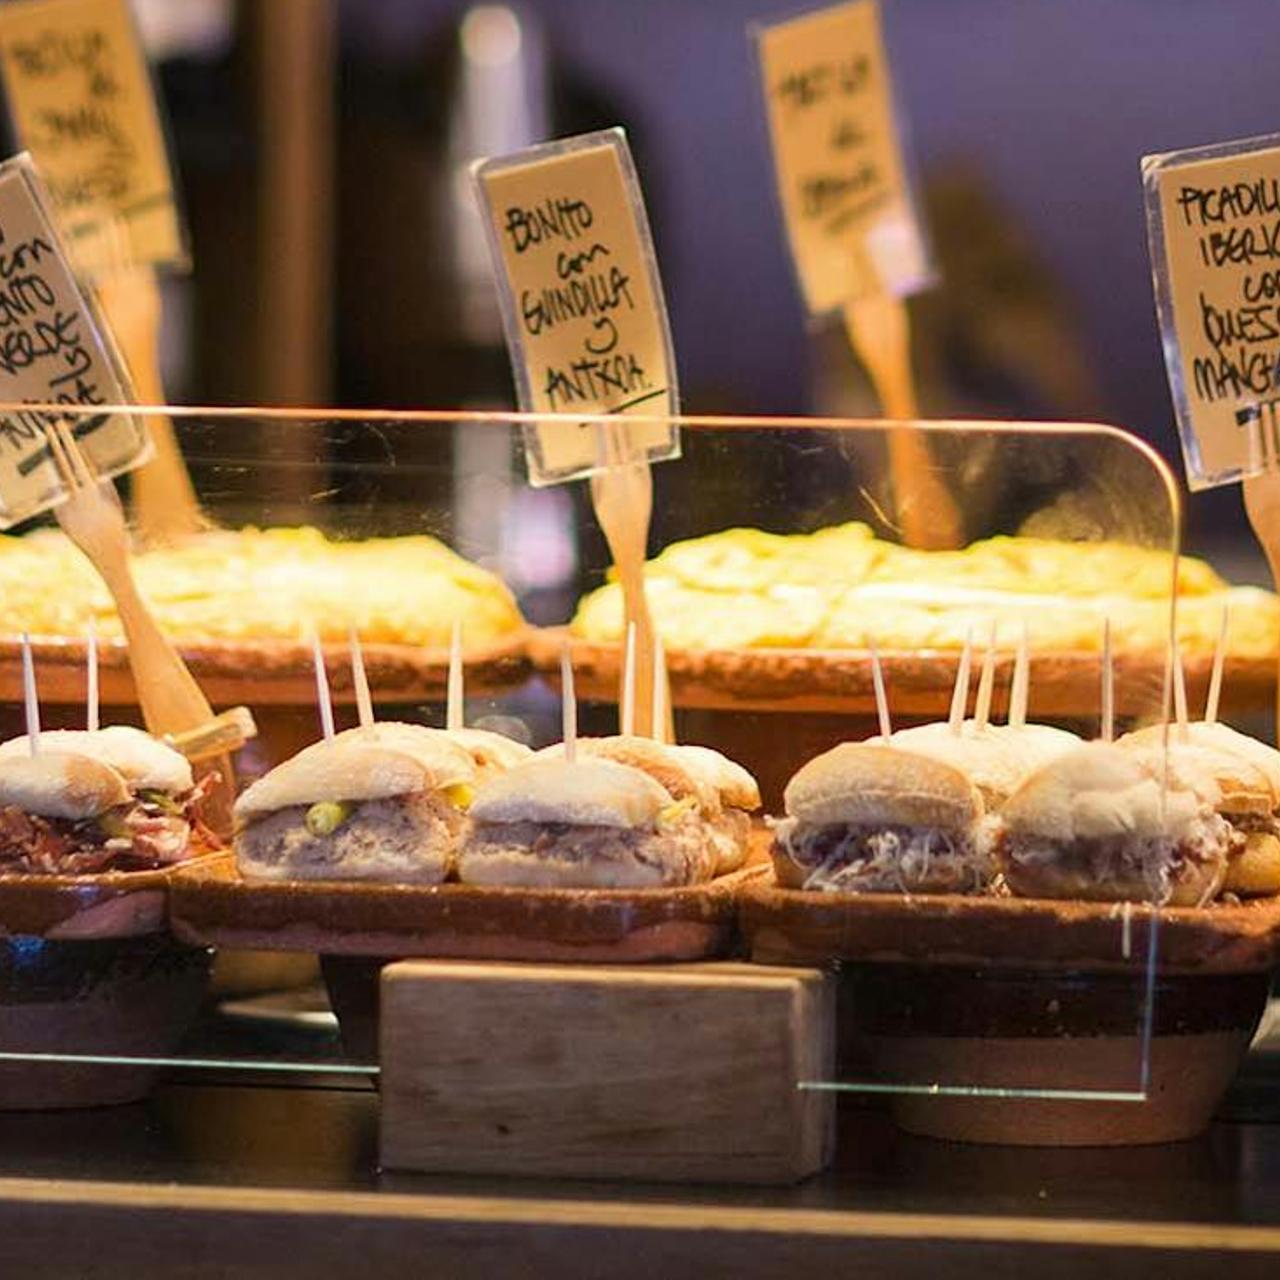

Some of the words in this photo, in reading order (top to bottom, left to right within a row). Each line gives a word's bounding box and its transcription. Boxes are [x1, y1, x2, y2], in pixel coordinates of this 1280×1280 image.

[505, 197, 594, 254] BONITO
[556, 242, 611, 280] con
[522, 266, 635, 336] GUINDILLA
